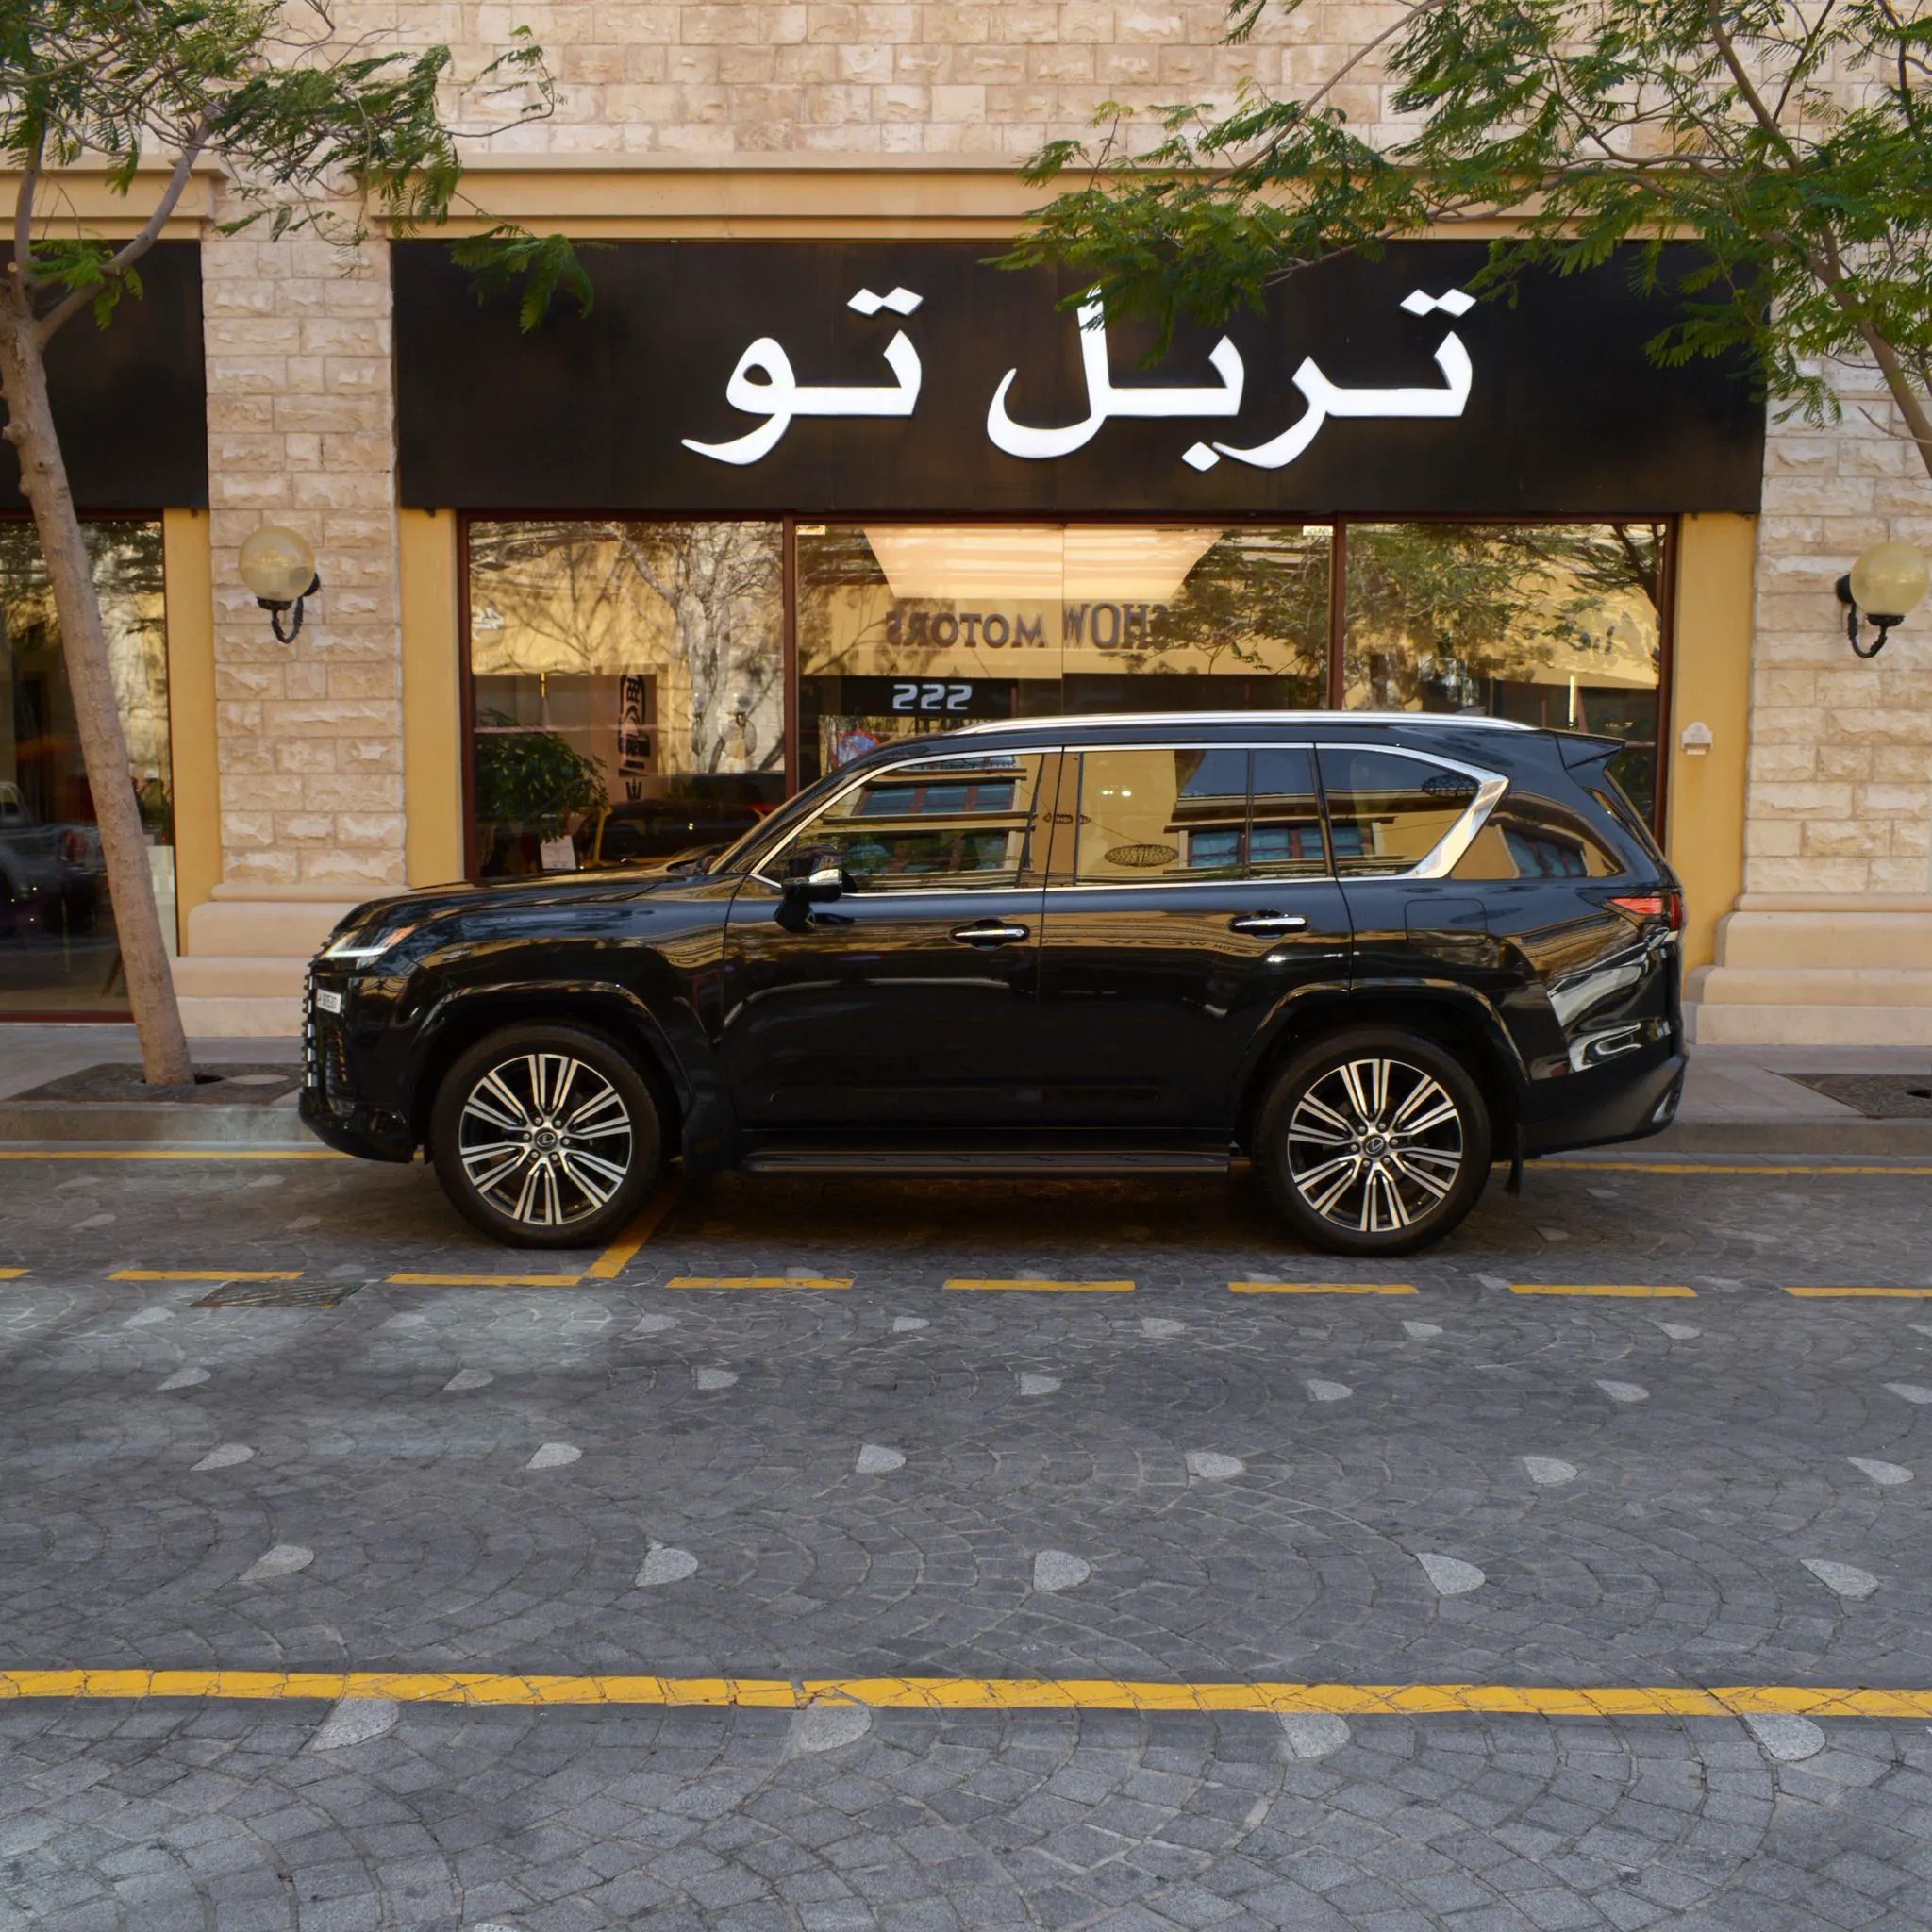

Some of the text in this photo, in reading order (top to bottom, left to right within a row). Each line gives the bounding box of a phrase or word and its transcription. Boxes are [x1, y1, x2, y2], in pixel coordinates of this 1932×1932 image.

[681, 285, 1477, 472] تربل تو
[891, 683, 973, 710] 222
